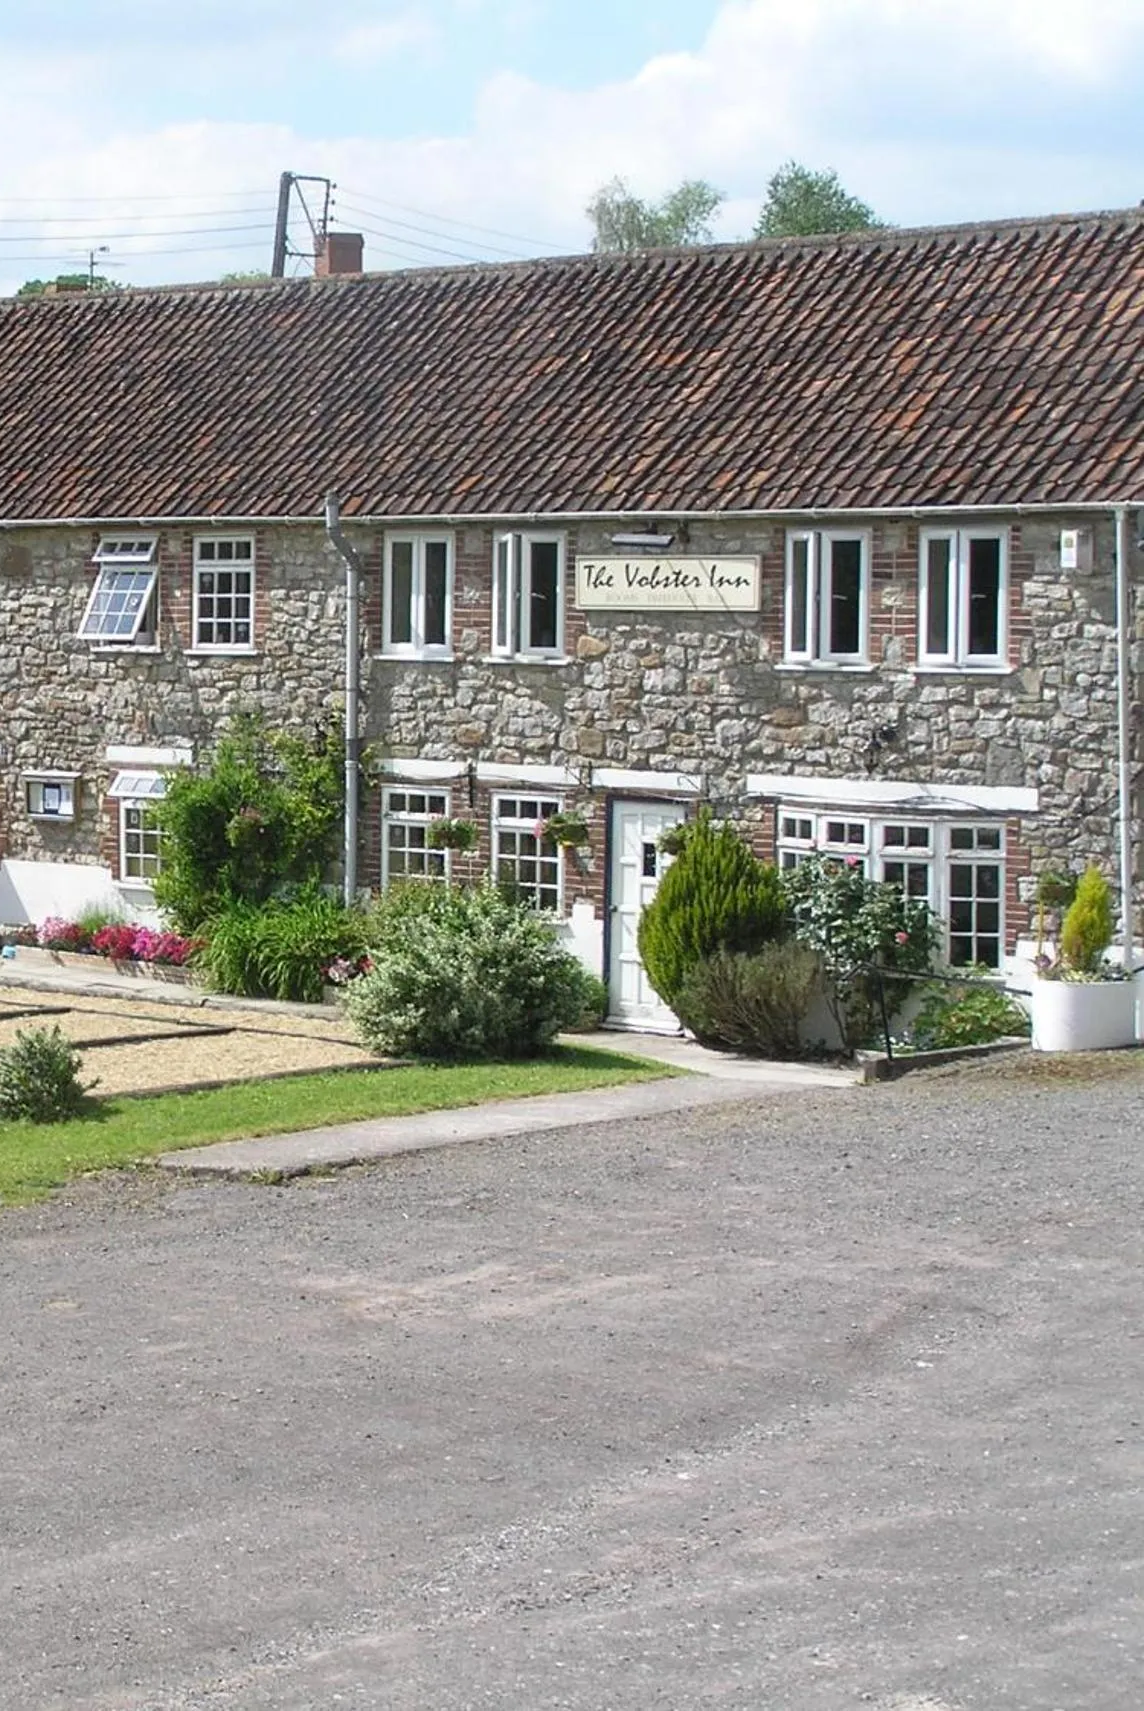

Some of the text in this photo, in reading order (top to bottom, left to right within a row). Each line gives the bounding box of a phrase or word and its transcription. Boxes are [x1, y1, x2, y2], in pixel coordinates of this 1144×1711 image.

[584, 563, 750, 589] The Vobster Inn
